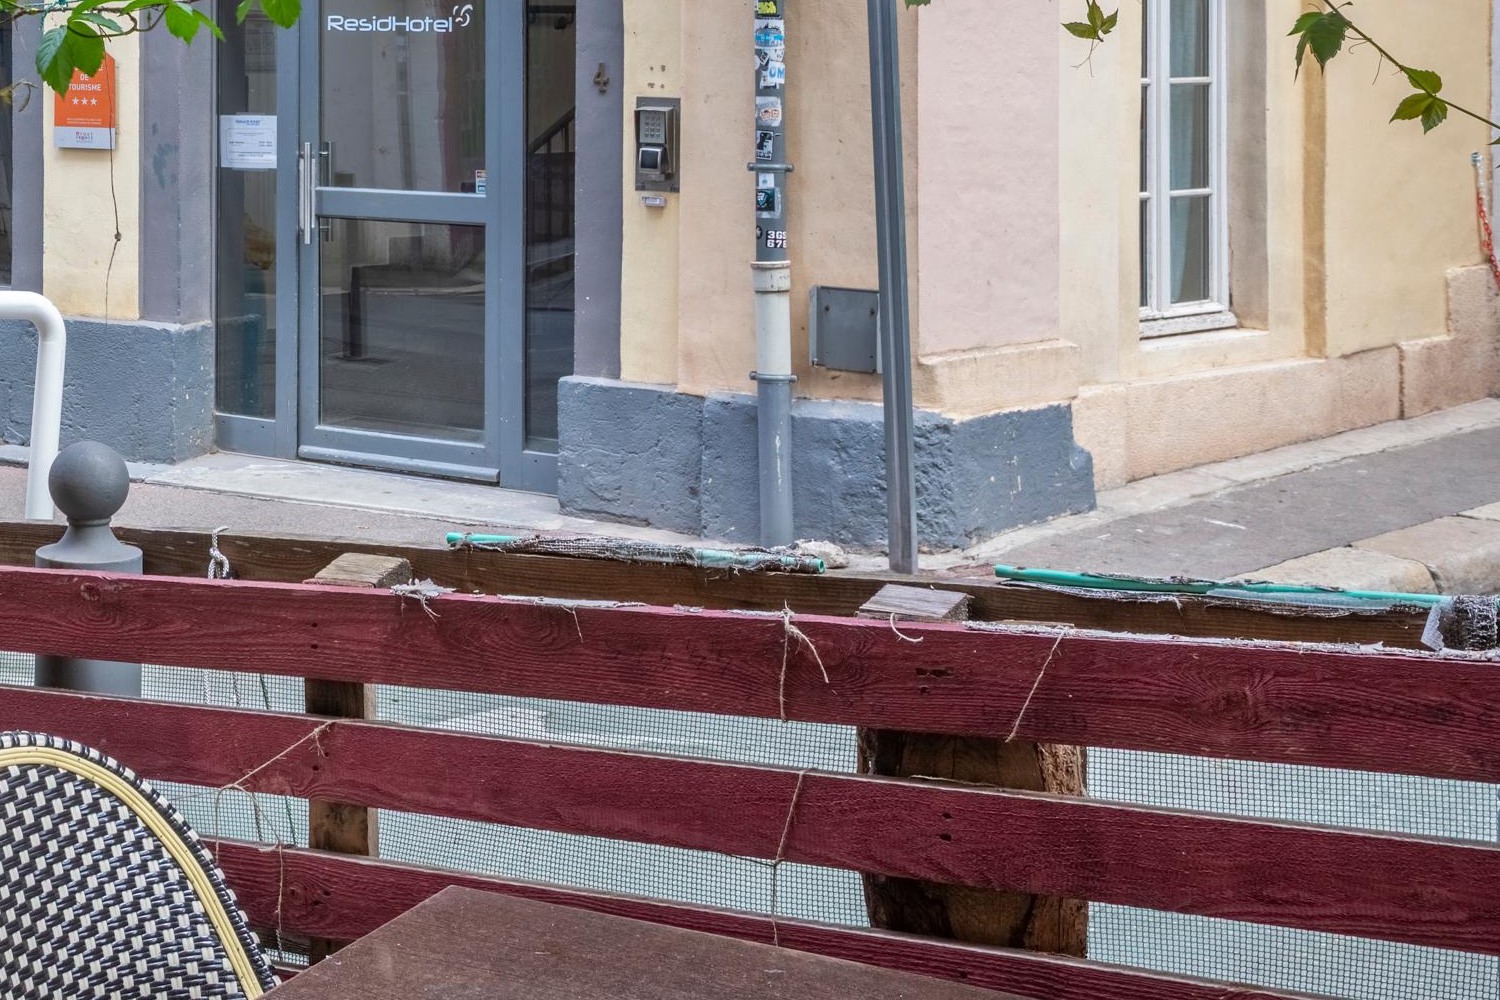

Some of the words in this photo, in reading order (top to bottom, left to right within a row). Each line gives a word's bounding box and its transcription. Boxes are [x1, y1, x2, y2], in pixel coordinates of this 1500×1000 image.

[327, 15, 453, 32] ResidHotel
[593, 62, 610, 94] 4
[68, 83, 101, 91] TOURISME
